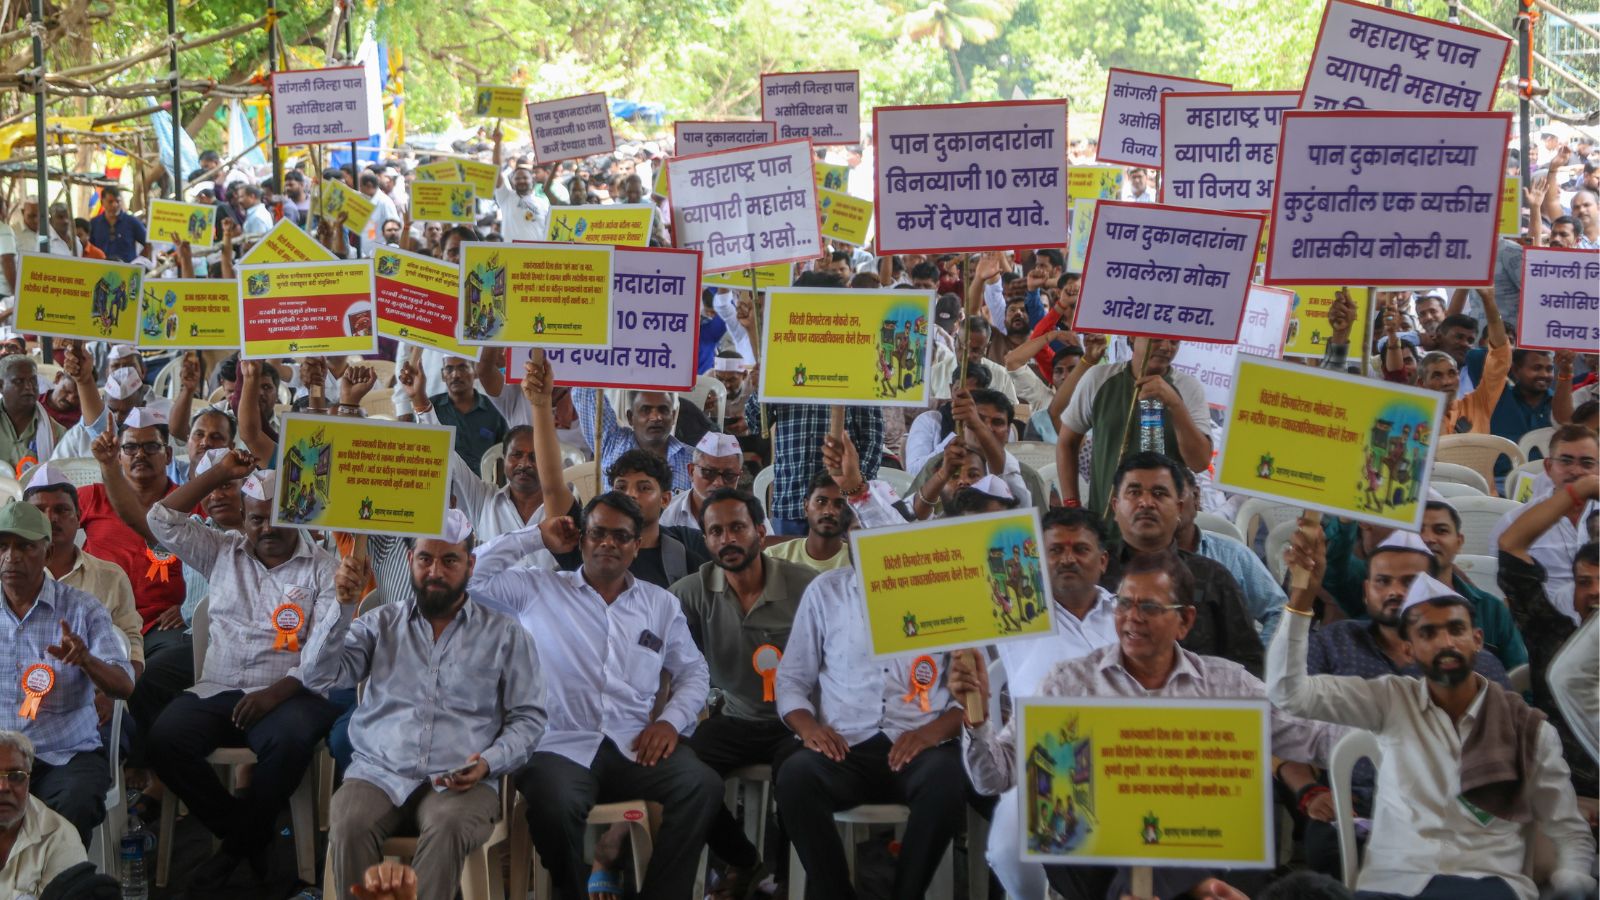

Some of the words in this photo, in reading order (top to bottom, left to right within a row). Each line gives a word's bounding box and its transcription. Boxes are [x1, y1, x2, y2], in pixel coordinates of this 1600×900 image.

[1349, 18, 1434, 61] महाराष्ट्र
[1437, 39, 1481, 69] पान
[278, 79, 311, 93] सांगली
[313, 77, 341, 91] जिल्हा
[343, 78, 362, 89] पान
[767, 82, 801, 96] सांगली
[803, 80, 832, 94] जिल्हा
[835, 82, 855, 93] पान
[1113, 82, 1157, 102] सांगली
[1326, 55, 1402, 94] व्यापारी
[1403, 74, 1482, 111] महासंघ
[286, 100, 343, 114] असोसिएशन
[345, 100, 356, 111] चा
[534, 112, 551, 122] पान
[775, 103, 833, 117] असोसिएशन
[836, 104, 848, 115] चा
[1186, 107, 1260, 128] महाराष्ट्र
[1264, 106, 1287, 126] पा
[293, 122, 320, 136] विजय
[577, 123, 586, 132] 10
[587, 119, 606, 130] लाख
[781, 125, 809, 138] विजय
[1118, 112, 1161, 130] असोसि
[684, 132, 703, 143] पान
[706, 129, 768, 147] दुकानदारांना
[889, 133, 929, 154] पान
[933, 123, 1054, 162] दुकानदारांना
[1121, 137, 1157, 157] विजय
[1174, 137, 1242, 163] व्यापारी
[1245, 143, 1278, 164] मह
[1308, 144, 1347, 166] पान
[1350, 139, 1479, 175] दुकानदारांच्या
[689, 161, 755, 189] महाराष्ट्र
[758, 155, 792, 177] पान
[886, 163, 981, 193] बिनव्याजी
[986, 169, 1007, 190] 10
[1012, 167, 1059, 188] लाख
[1173, 180, 1195, 199] चा
[1198, 173, 1252, 199] विजय
[682, 193, 742, 224] व्यापारी
[745, 186, 806, 216] महासंघ
[1283, 184, 1379, 223] कुटुंबातील
[1382, 192, 1417, 213] एक
[1420, 185, 1492, 213] व्यक्तीस
[896, 204, 937, 231] कर्जे
[939, 204, 1002, 231] देण्यात
[1006, 200, 1049, 227] यावे.
[707, 232, 755, 257] विजय
[759, 222, 812, 250] असो...
[1106, 222, 1140, 242] पान
[1142, 224, 1248, 252] दुकानदारांना
[1291, 230, 1377, 259] शासकीय
[1379, 231, 1442, 259] नोकरी
[1446, 238, 1473, 260] द्या.
[1106, 259, 1181, 285] लावलेला
[1183, 263, 1230, 289] मोका
[1531, 261, 1581, 280] सांगली
[1584, 262, 1600, 280] जि
[614, 269, 686, 296] नदारांना
[1102, 296, 1152, 320] आदेश
[1153, 302, 1175, 324] रद्द
[1177, 305, 1214, 327] करा.
[1540, 291, 1600, 310] असोसिए
[617, 310, 637, 330] 10
[642, 311, 688, 334] लाख
[789, 311, 805, 326] विदेशी
[797, 332, 807, 343] पान
[845, 331, 856, 344] केले
[1546, 320, 1588, 340] विजय
[571, 347, 631, 366] दण्यात
[635, 343, 676, 369] यावे.
[1201, 367, 1232, 390] थांबव
[884, 553, 902, 570] विदेशी
[897, 576, 909, 588] पान
